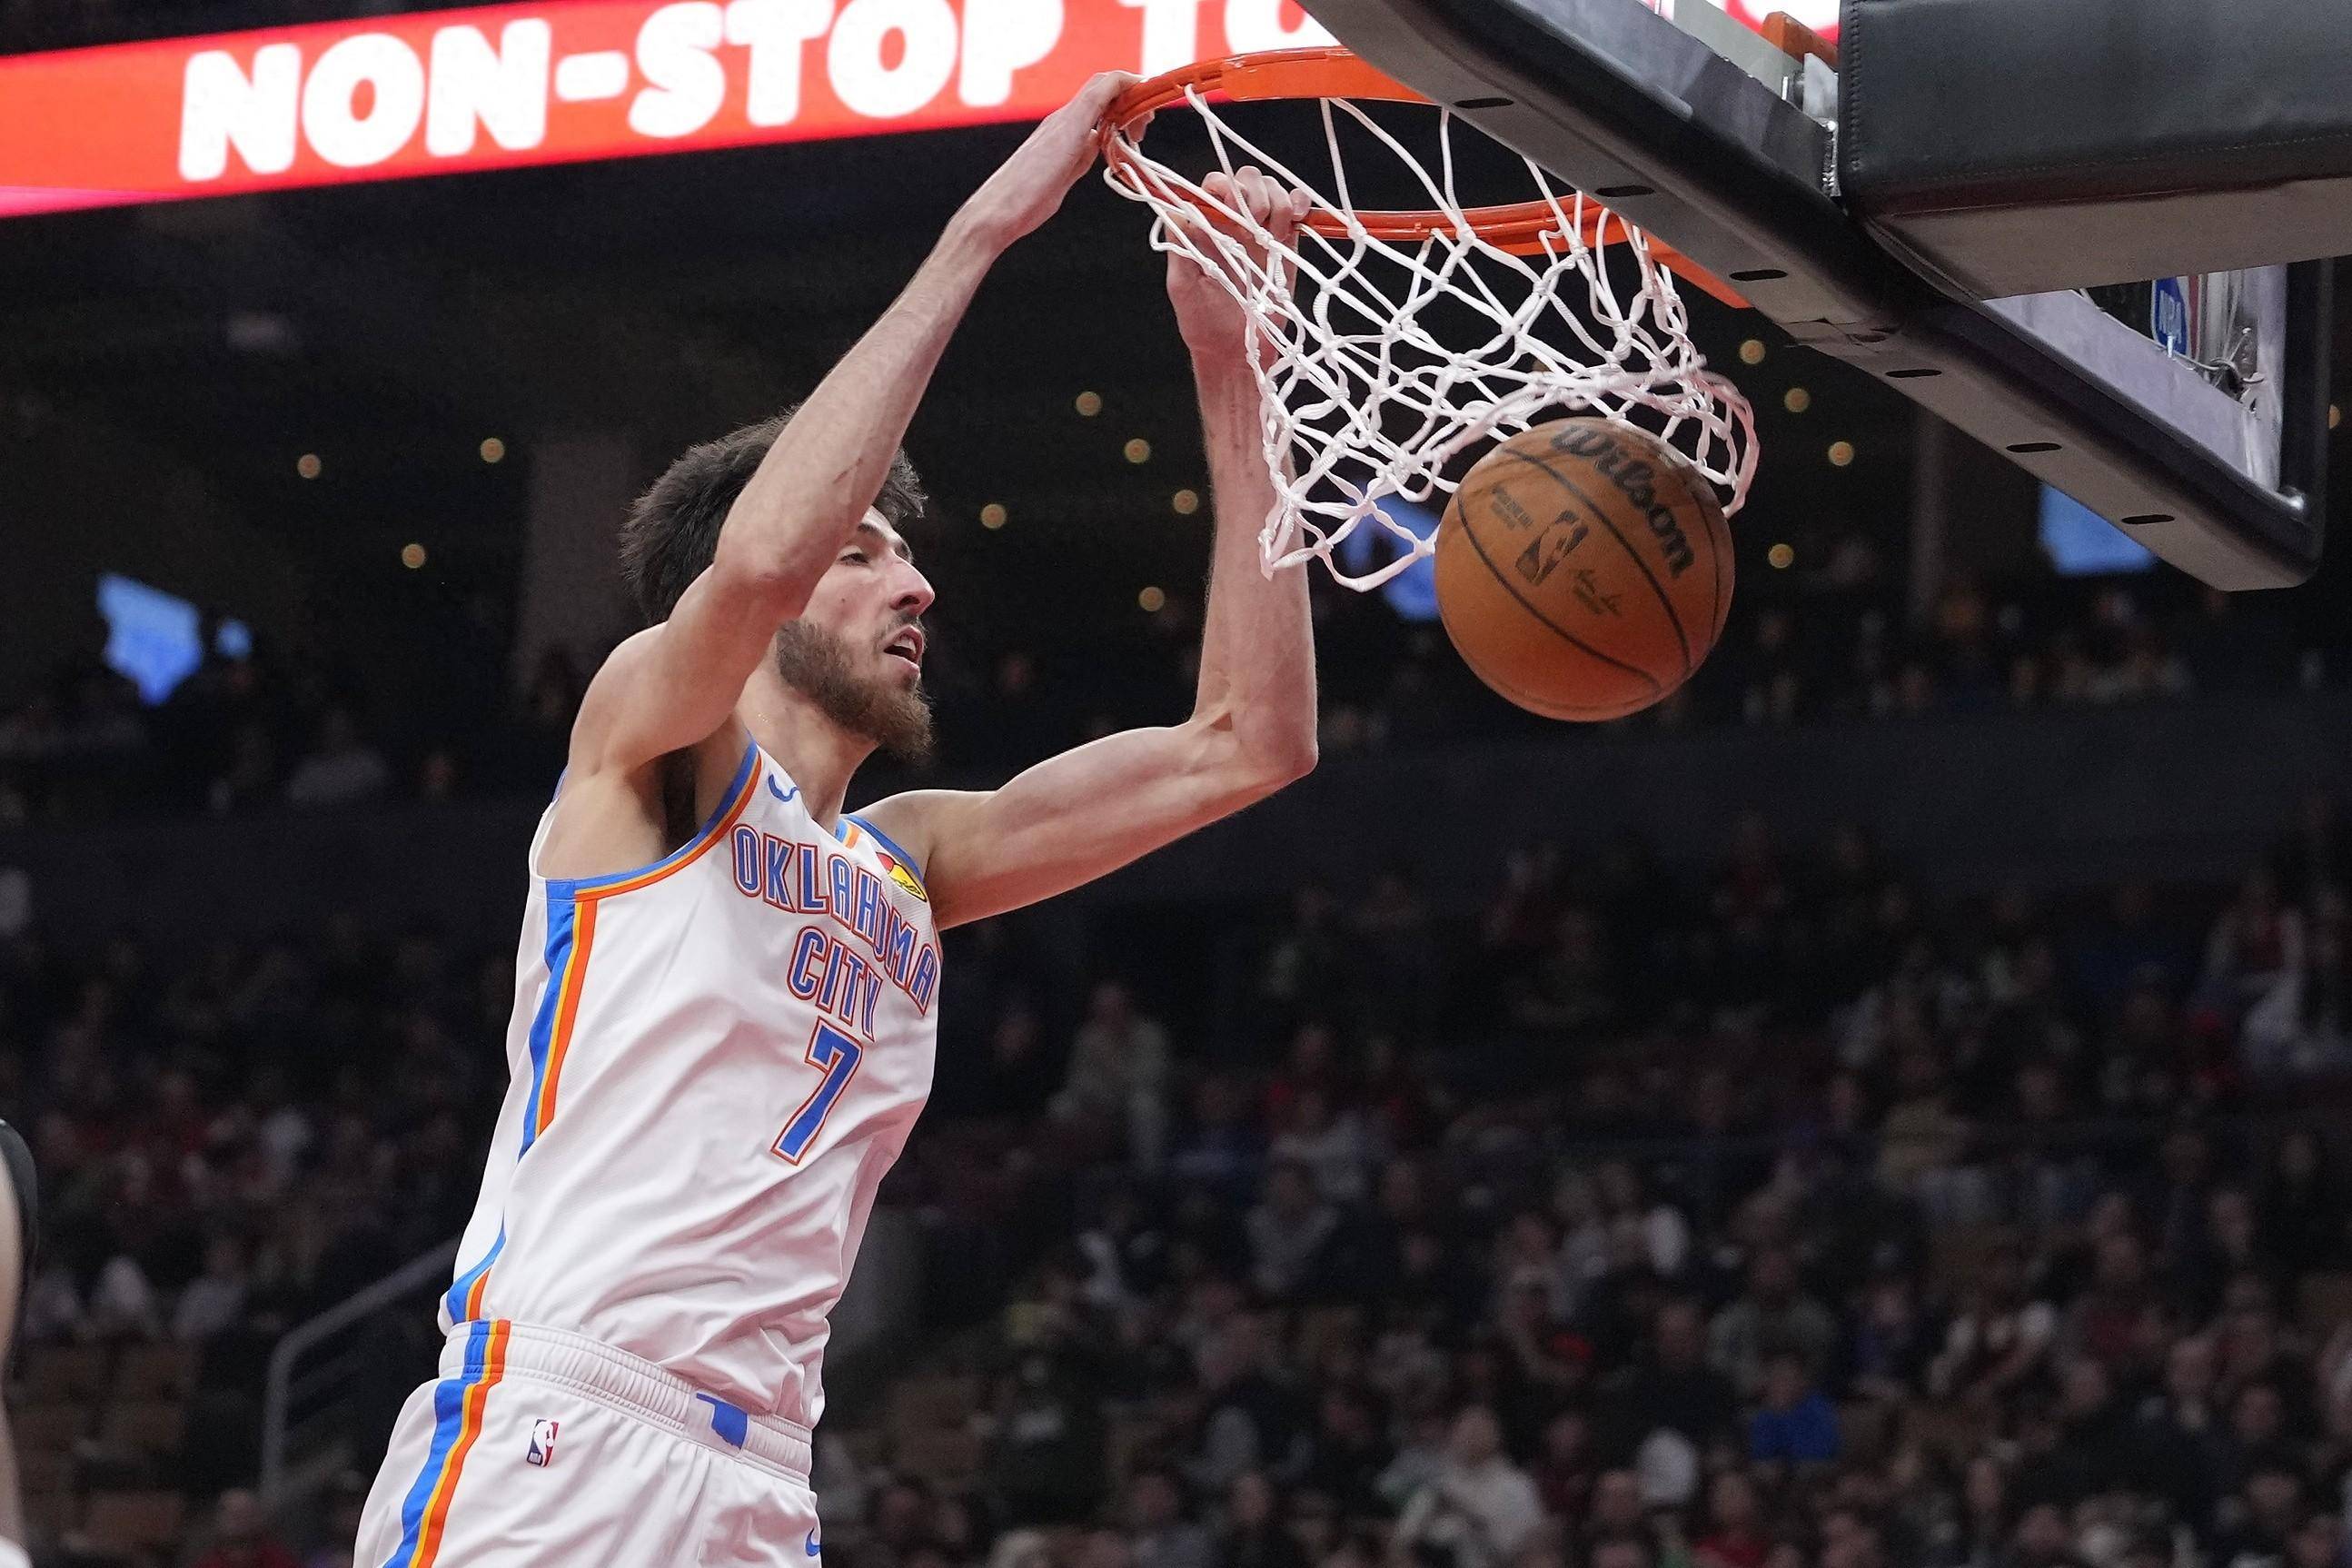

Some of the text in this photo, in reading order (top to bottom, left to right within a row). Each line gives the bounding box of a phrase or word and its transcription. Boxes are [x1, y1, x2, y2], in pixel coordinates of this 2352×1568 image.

[177, 0, 1064, 181] NON-STOP
[1551, 424, 1695, 579] Wilson
[730, 823, 938, 1017] OKLAHOMA
[787, 926, 882, 1043] CITY
[771, 1016, 864, 1166] 7
